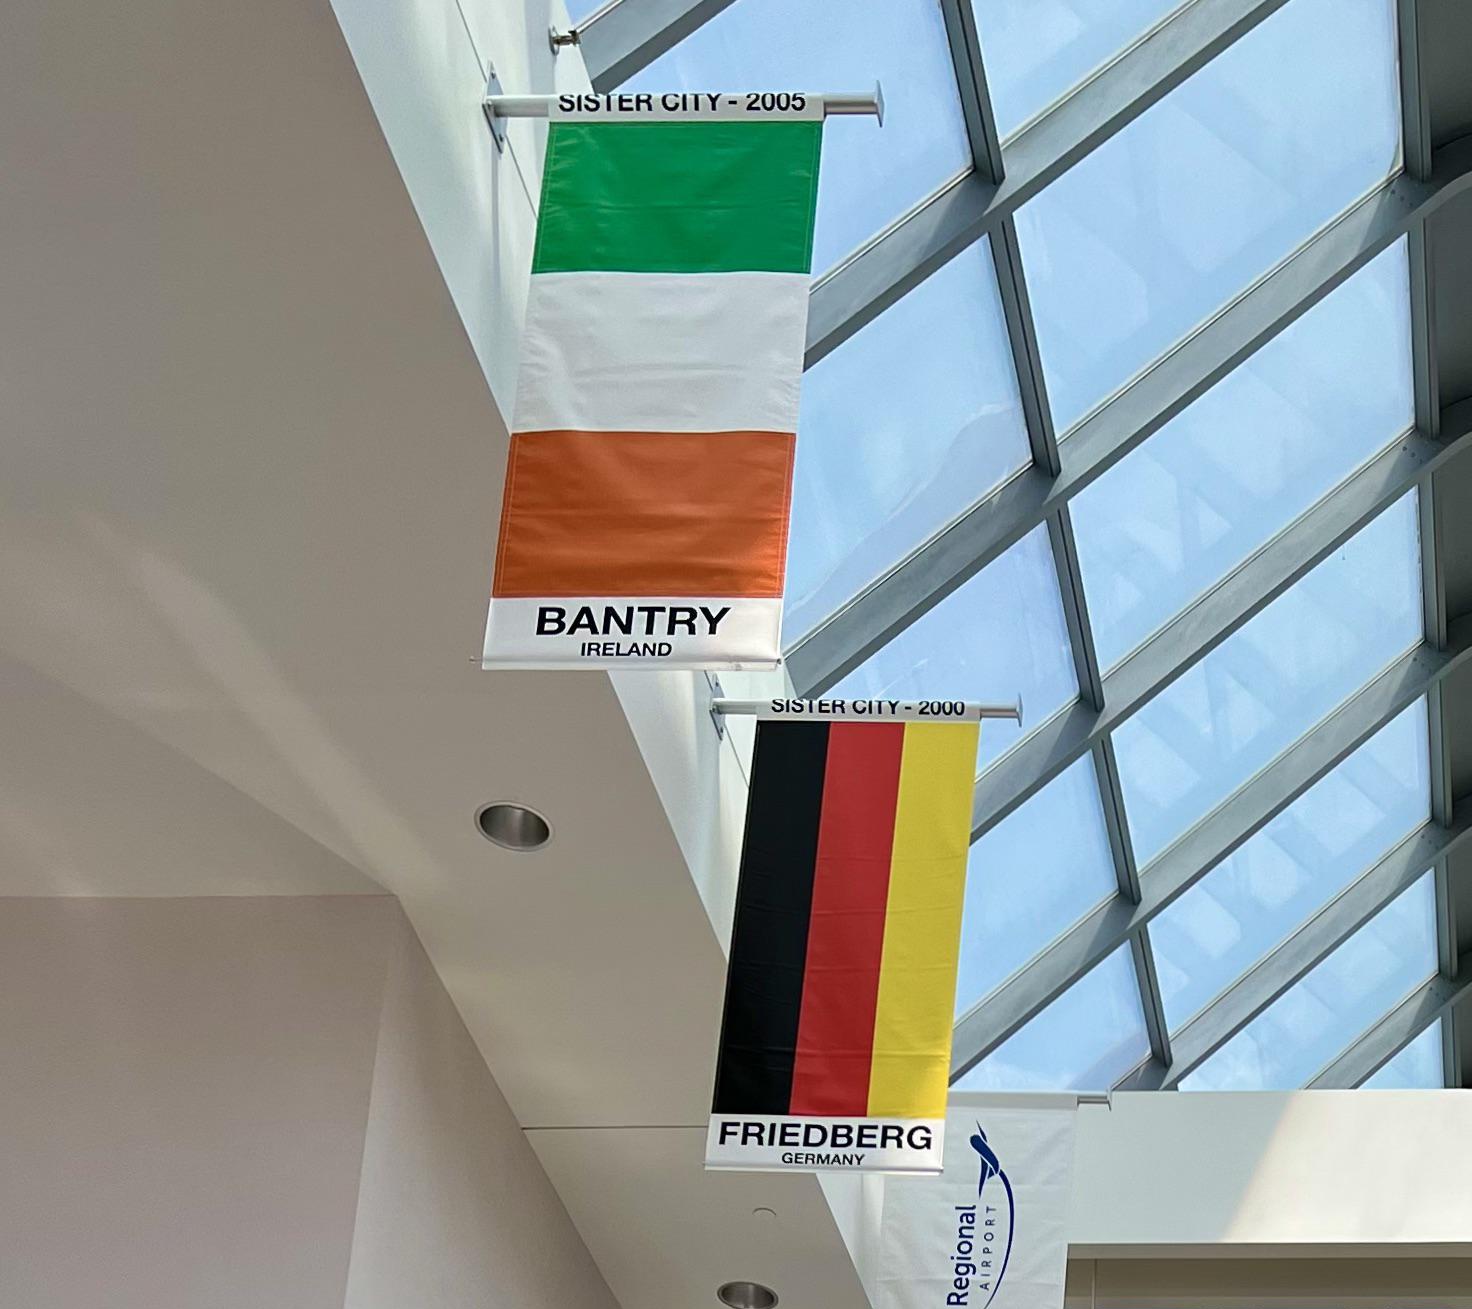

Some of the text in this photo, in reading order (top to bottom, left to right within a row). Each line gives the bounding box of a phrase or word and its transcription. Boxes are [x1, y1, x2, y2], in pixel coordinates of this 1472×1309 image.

[558, 93, 652, 112] SISTER
[661, 93, 722, 112] CITY
[746, 93, 806, 111] 2005
[535, 606, 732, 636] BANTRY
[580, 642, 672, 657] IRELAND
[771, 698, 846, 714] SISTER
[852, 699, 900, 715] CITY
[918, 700, 966, 716] 2000
[718, 1121, 933, 1150] FRIEDBERG
[781, 1152, 865, 1166] GERMANY
[946, 1204, 977, 1307] Regional
[979, 1205, 998, 1291] AIRPORT
